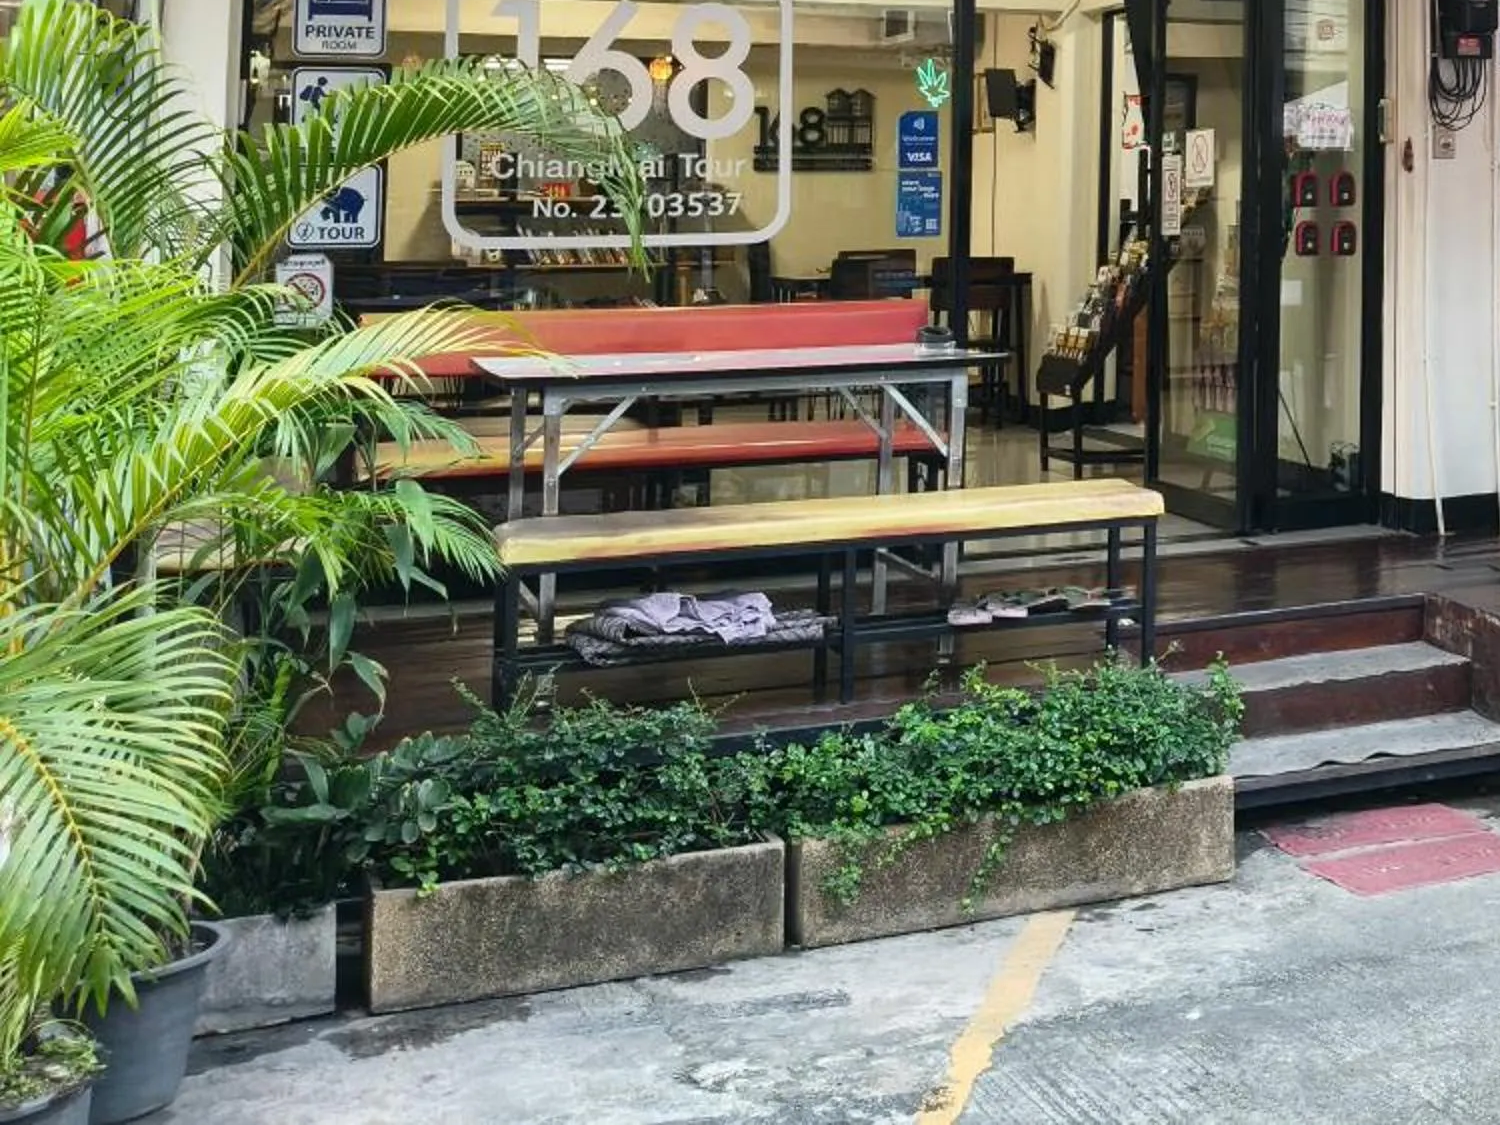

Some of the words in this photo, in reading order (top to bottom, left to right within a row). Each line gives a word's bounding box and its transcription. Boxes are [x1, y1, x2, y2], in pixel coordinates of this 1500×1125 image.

[305, 24, 376, 40] PRIVATE
[321, 40, 357, 50] ROOM
[906, 151, 933, 163] VISA
[678, 152, 748, 178] Tour
[533, 195, 577, 218] No.
[589, 192, 744, 219] 203537
[317, 226, 366, 240] TOUR
